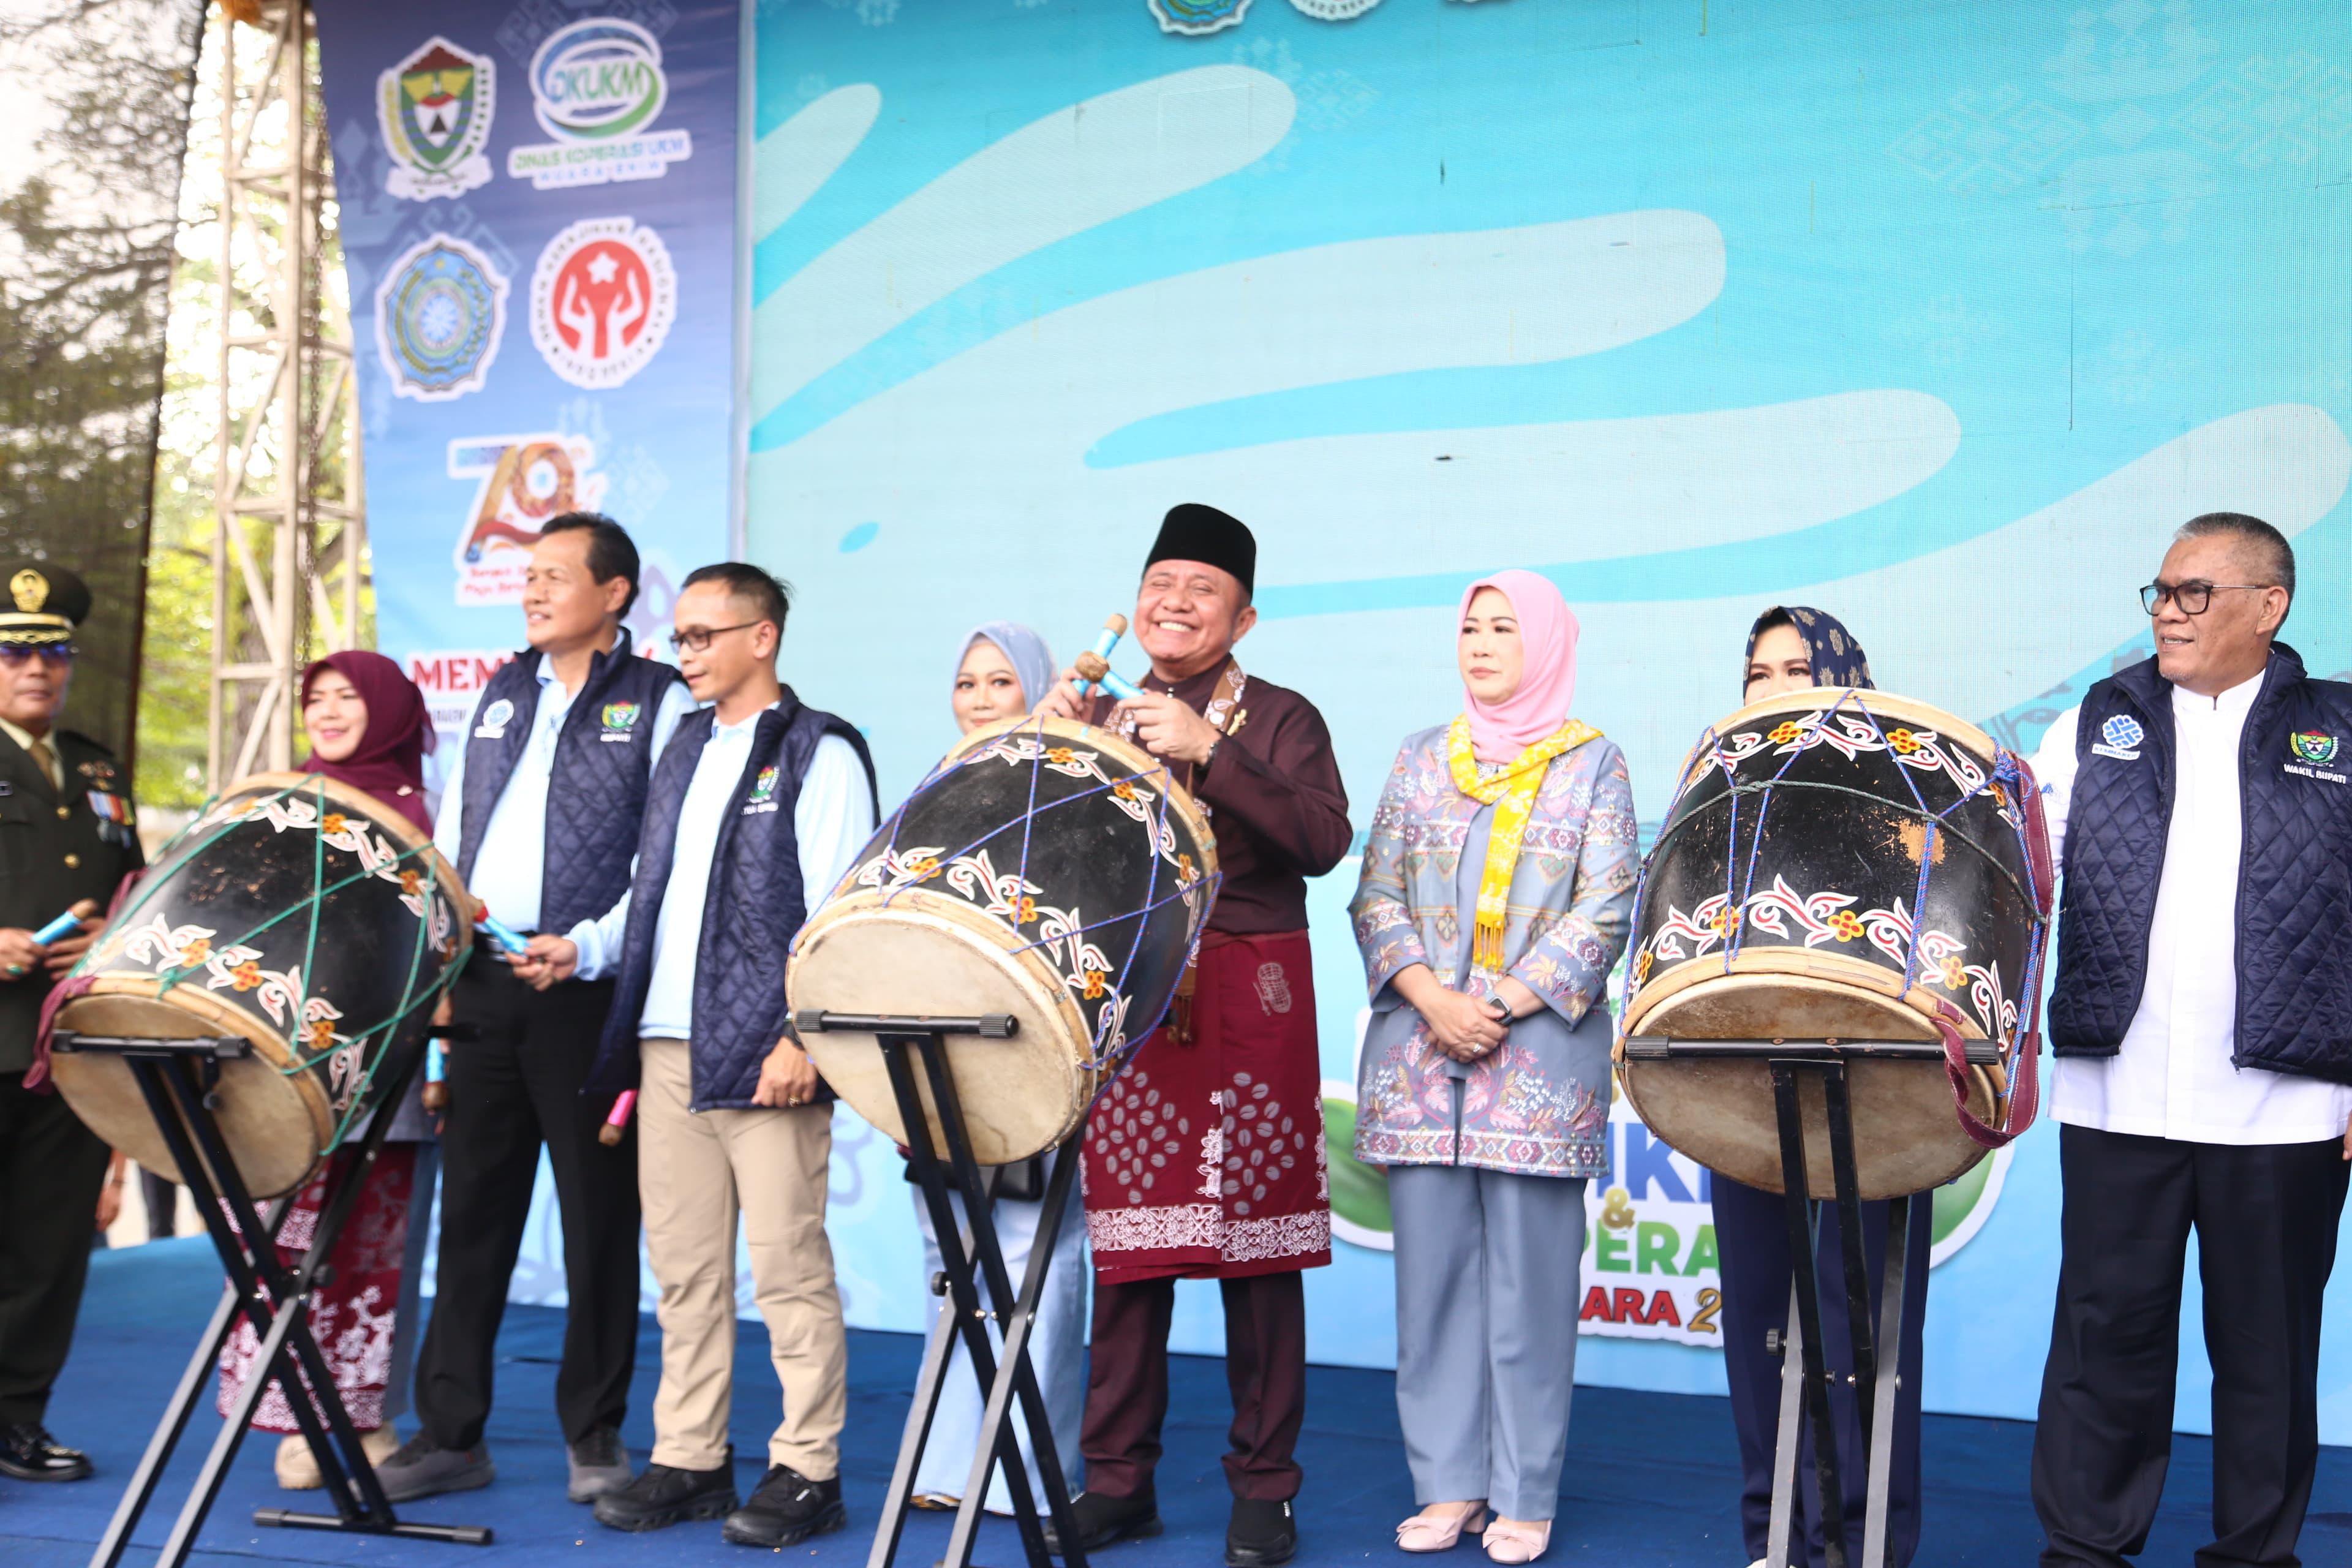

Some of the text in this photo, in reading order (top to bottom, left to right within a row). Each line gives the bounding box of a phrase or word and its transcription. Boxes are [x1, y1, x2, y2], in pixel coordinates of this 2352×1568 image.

[412, 657, 518, 692] MEM
[2283, 763, 2314, 778] WAKIL
[2316, 770, 2346, 784] BUPATI
[1579, 1285, 1722, 1334] ARA 2
